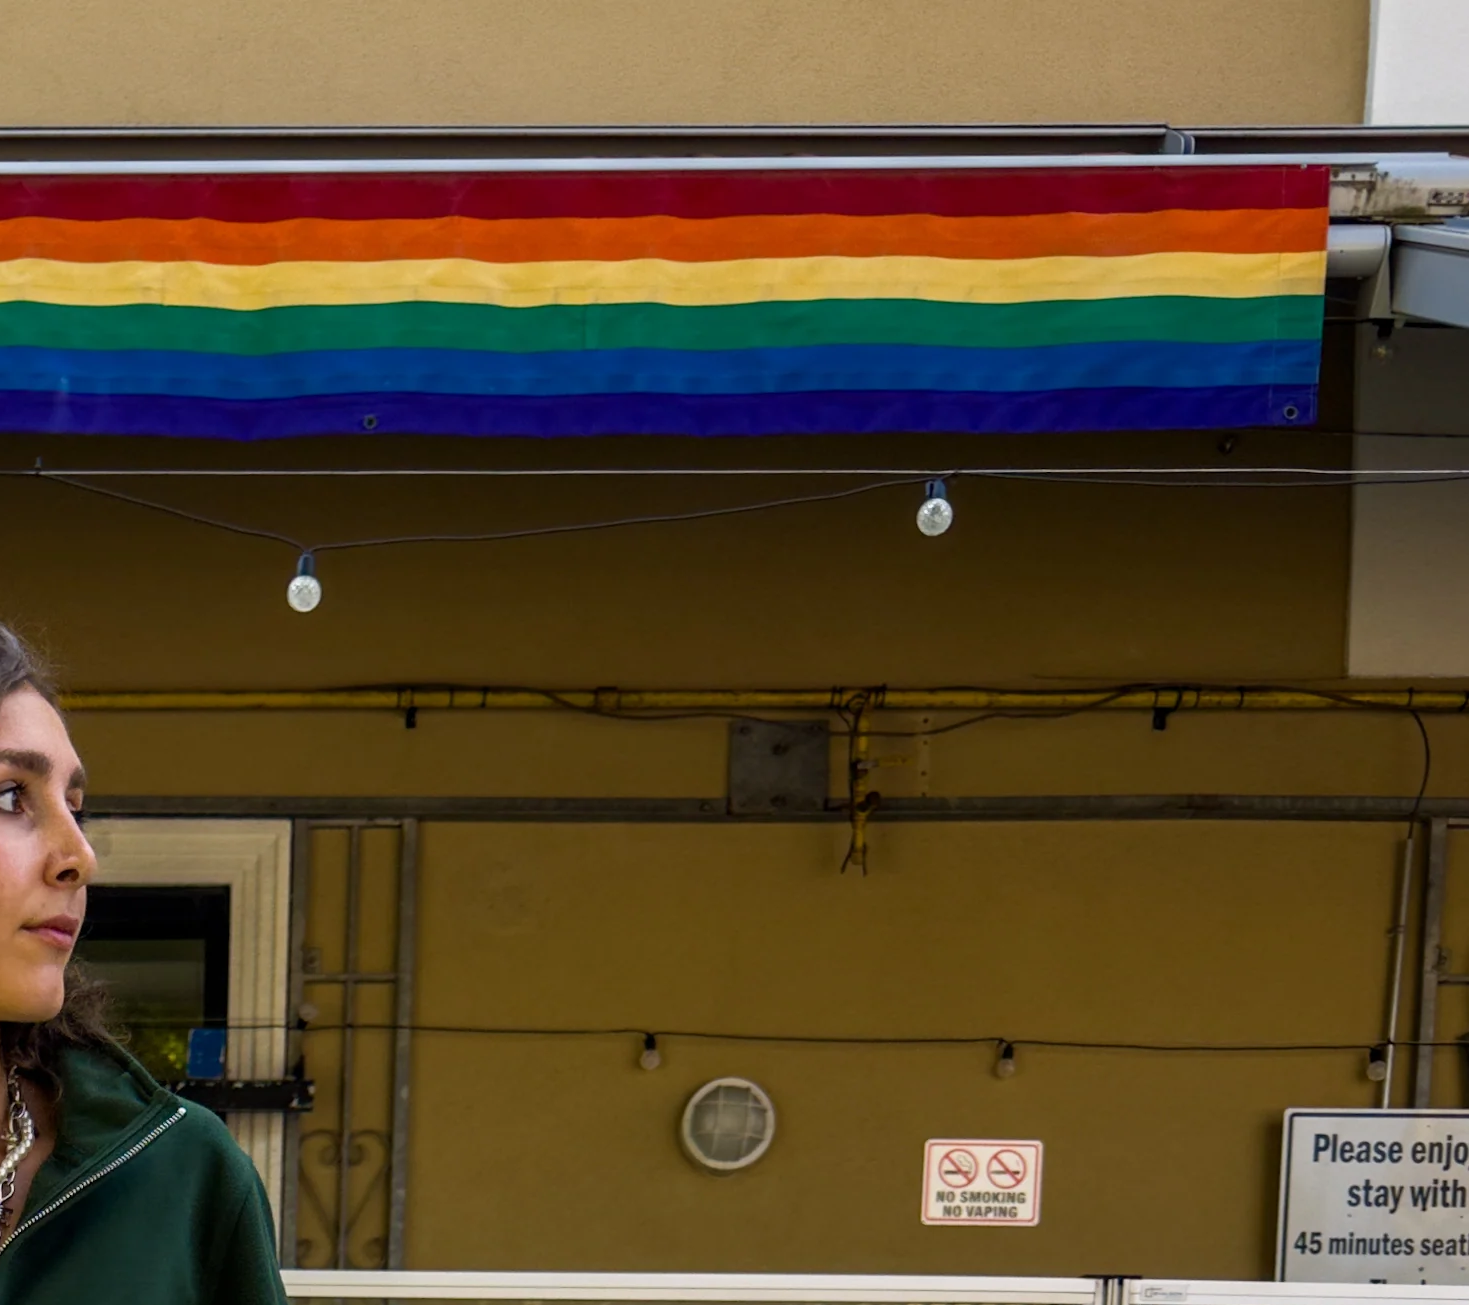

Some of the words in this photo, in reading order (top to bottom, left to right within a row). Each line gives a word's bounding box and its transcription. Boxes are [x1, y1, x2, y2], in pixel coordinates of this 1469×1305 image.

[1312, 1133, 1403, 1164] Please
[1411, 1134, 1469, 1172] enjo
[935, 1190, 956, 1204] NO
[959, 1190, 1027, 1204] SMOKING
[1346, 1178, 1405, 1214] stay
[1410, 1178, 1468, 1212] with
[942, 1204, 962, 1218] NO
[965, 1205, 1019, 1219] VAPING
[1294, 1231, 1322, 1256] 45
[1328, 1232, 1414, 1257] minutes
